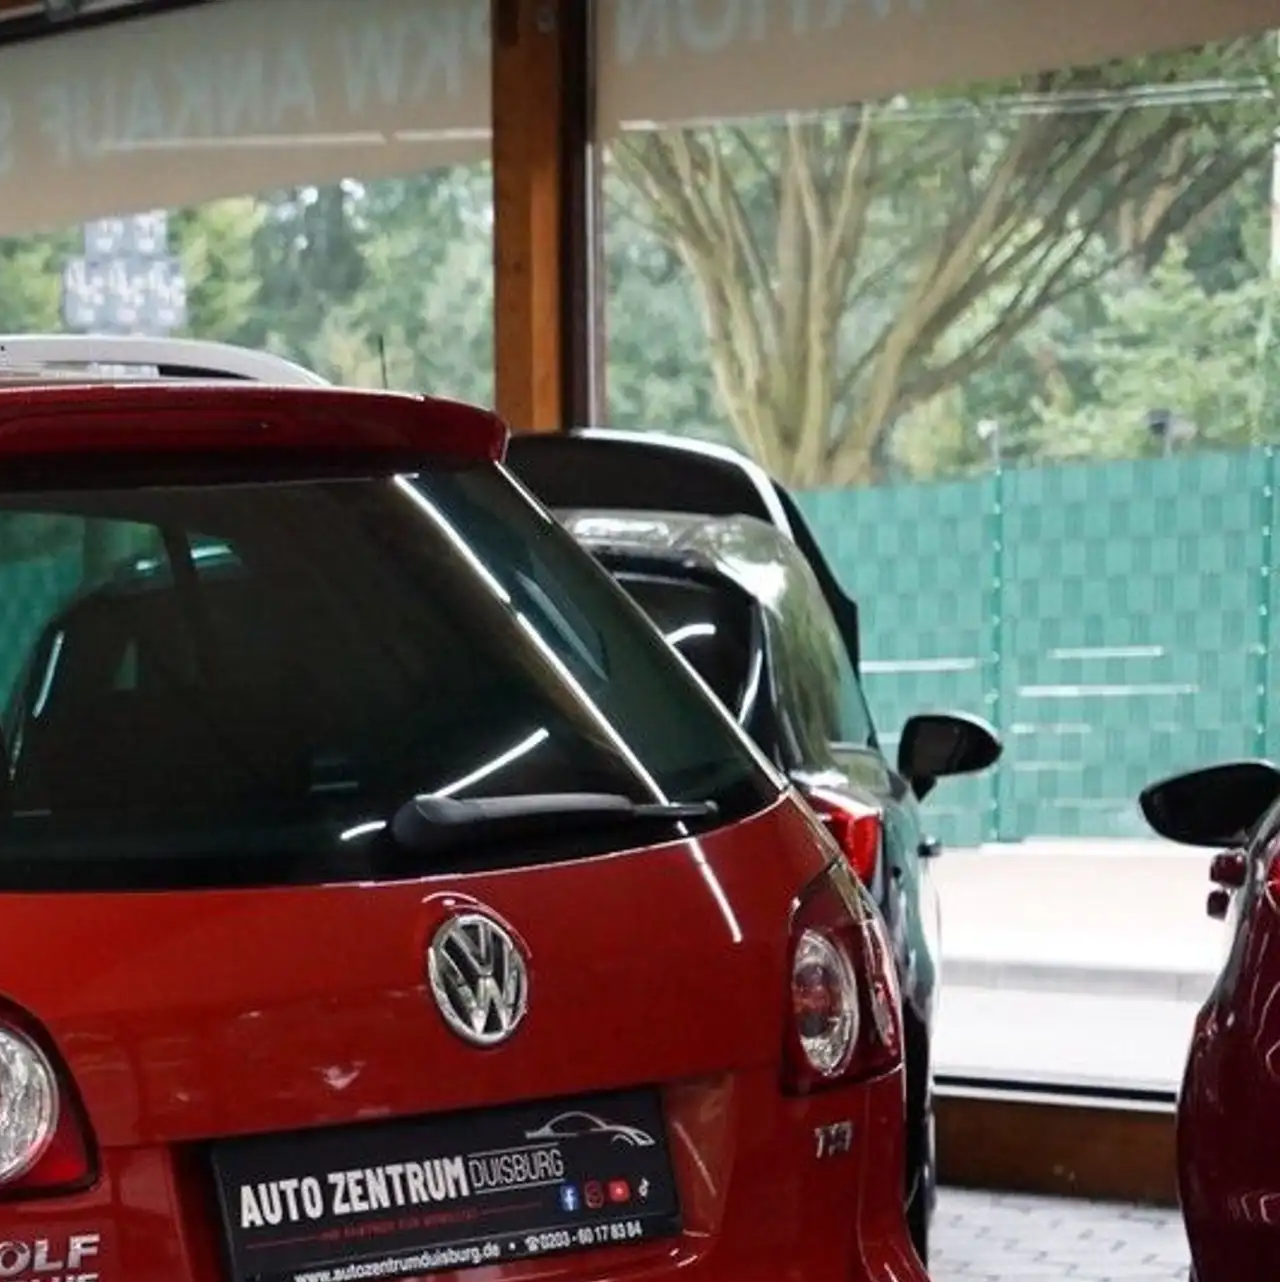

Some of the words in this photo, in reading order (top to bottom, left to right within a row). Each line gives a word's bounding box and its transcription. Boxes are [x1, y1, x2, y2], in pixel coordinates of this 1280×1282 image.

[240, 1177, 323, 1228] AUTO
[327, 1155, 471, 1215] ZENTRUM
[469, 1149, 565, 1188] DUISBURG
[595, 1224, 609, 1243] 17
